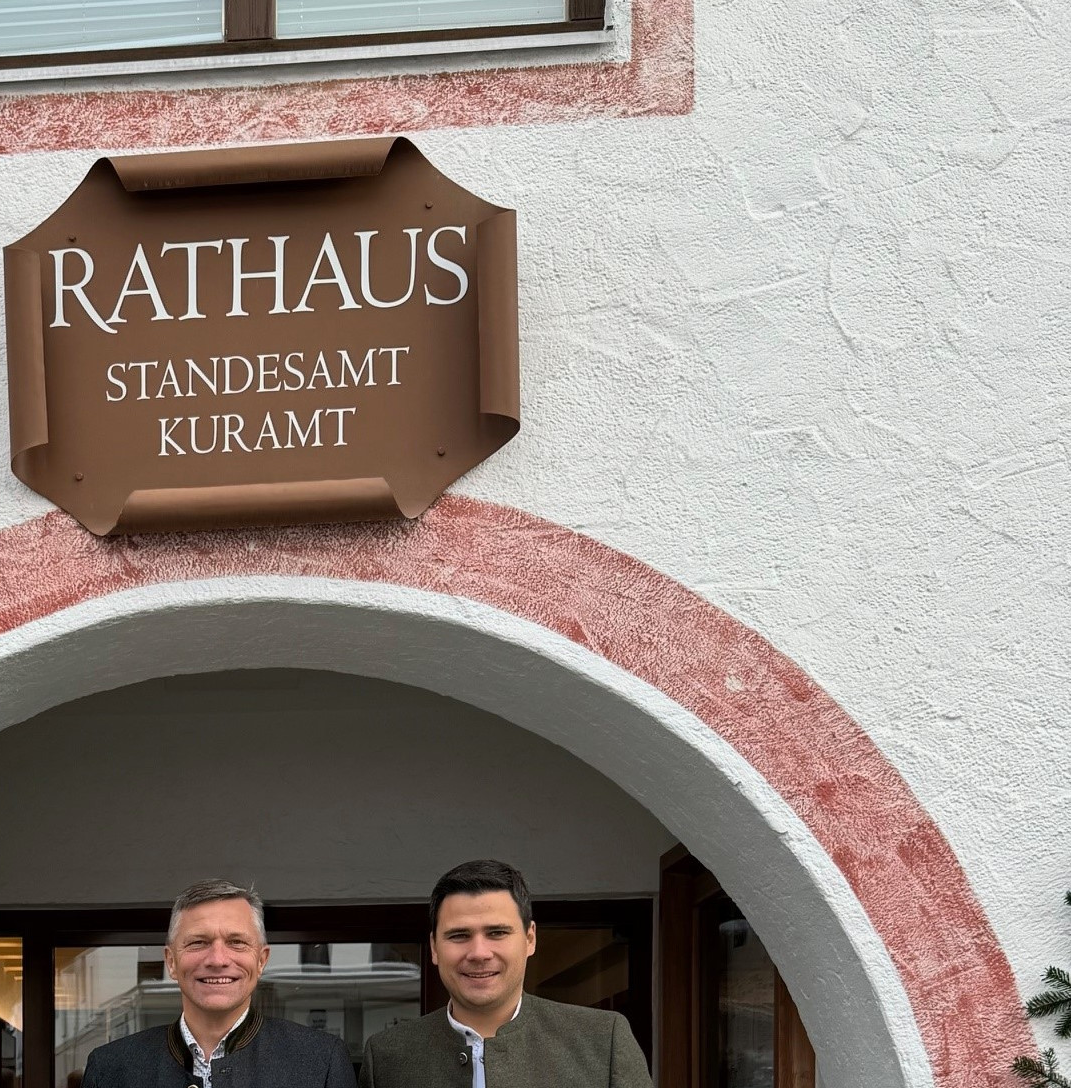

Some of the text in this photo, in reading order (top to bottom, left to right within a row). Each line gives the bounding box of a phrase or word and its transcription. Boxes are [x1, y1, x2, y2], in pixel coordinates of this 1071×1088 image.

[48, 225, 469, 334] RATHAUS
[105, 346, 410, 402] STANDESAMT
[158, 407, 356, 456] KURAMT
